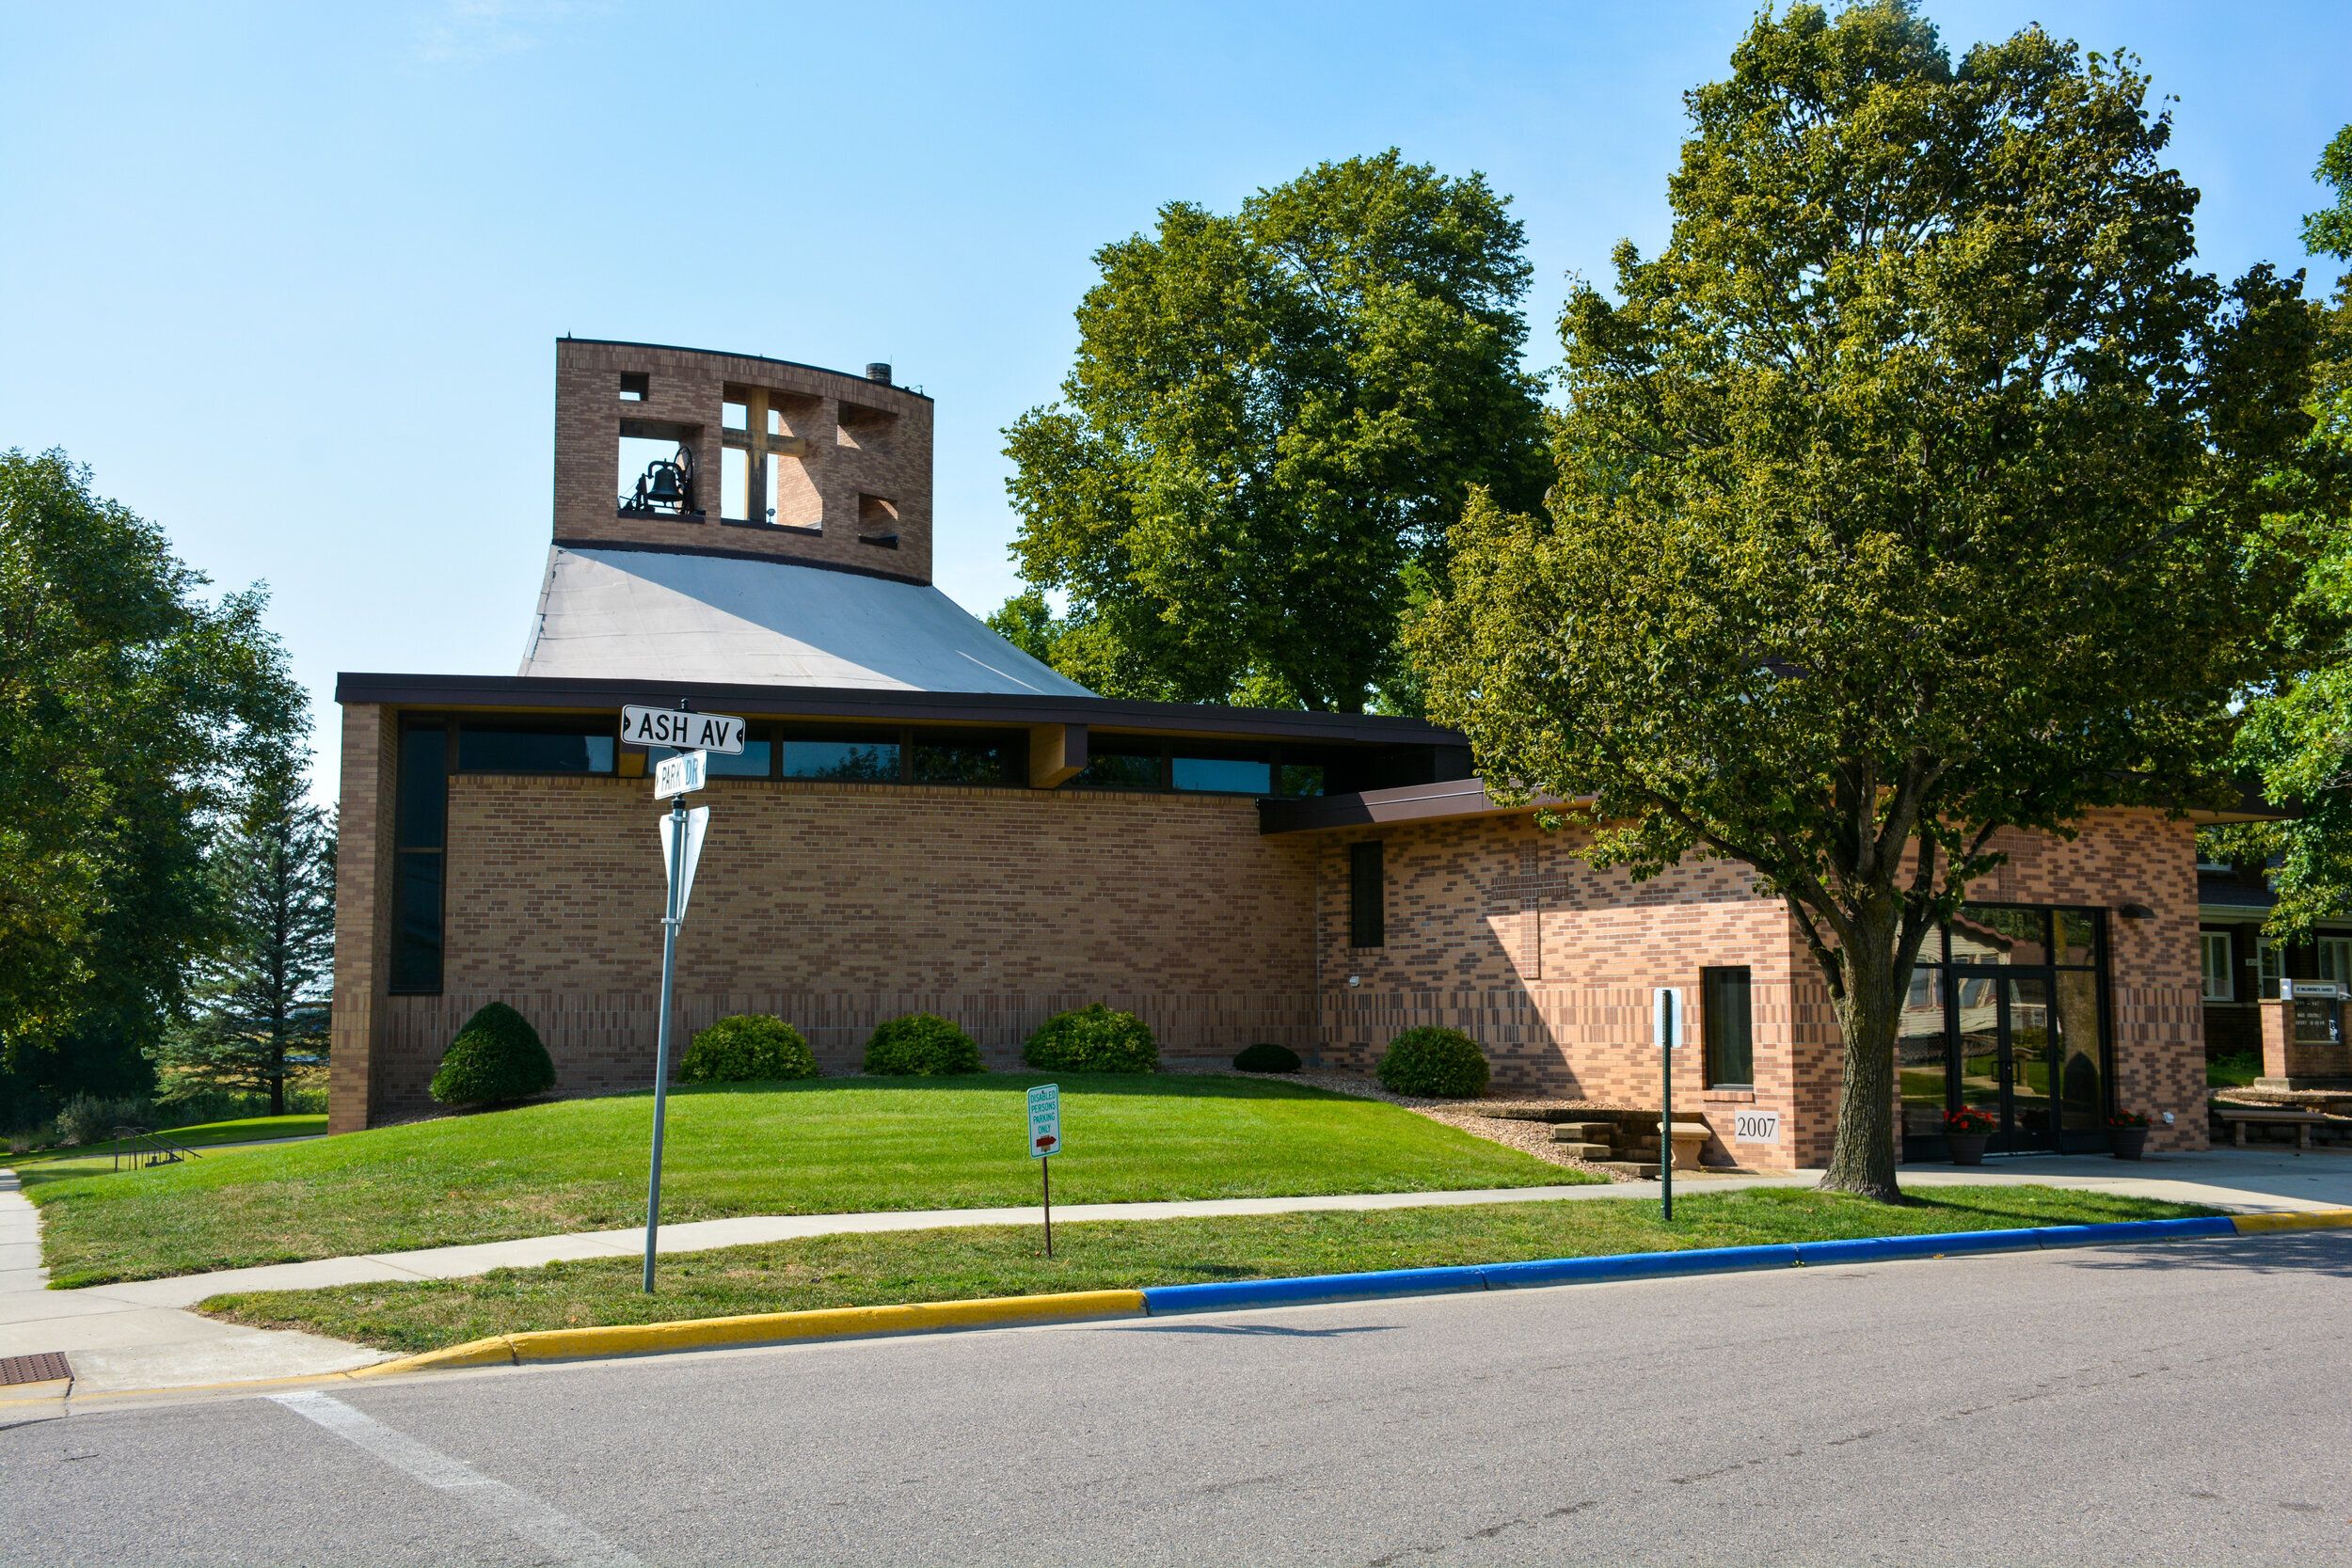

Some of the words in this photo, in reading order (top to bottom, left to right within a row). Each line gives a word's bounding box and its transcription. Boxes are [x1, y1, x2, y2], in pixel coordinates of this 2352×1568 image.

[638, 713, 689, 743] ASH
[700, 720, 730, 747] AV
[660, 761, 682, 792] PARK
[686, 758, 698, 785] DR
[1030, 1090, 1056, 1103] DISABLED
[1031, 1101, 1056, 1114] PERSONS
[1033, 1113, 1055, 1124] PARKING
[1038, 1124, 1051, 1134] ONLY
[1738, 1117, 1776, 1137] 2007
